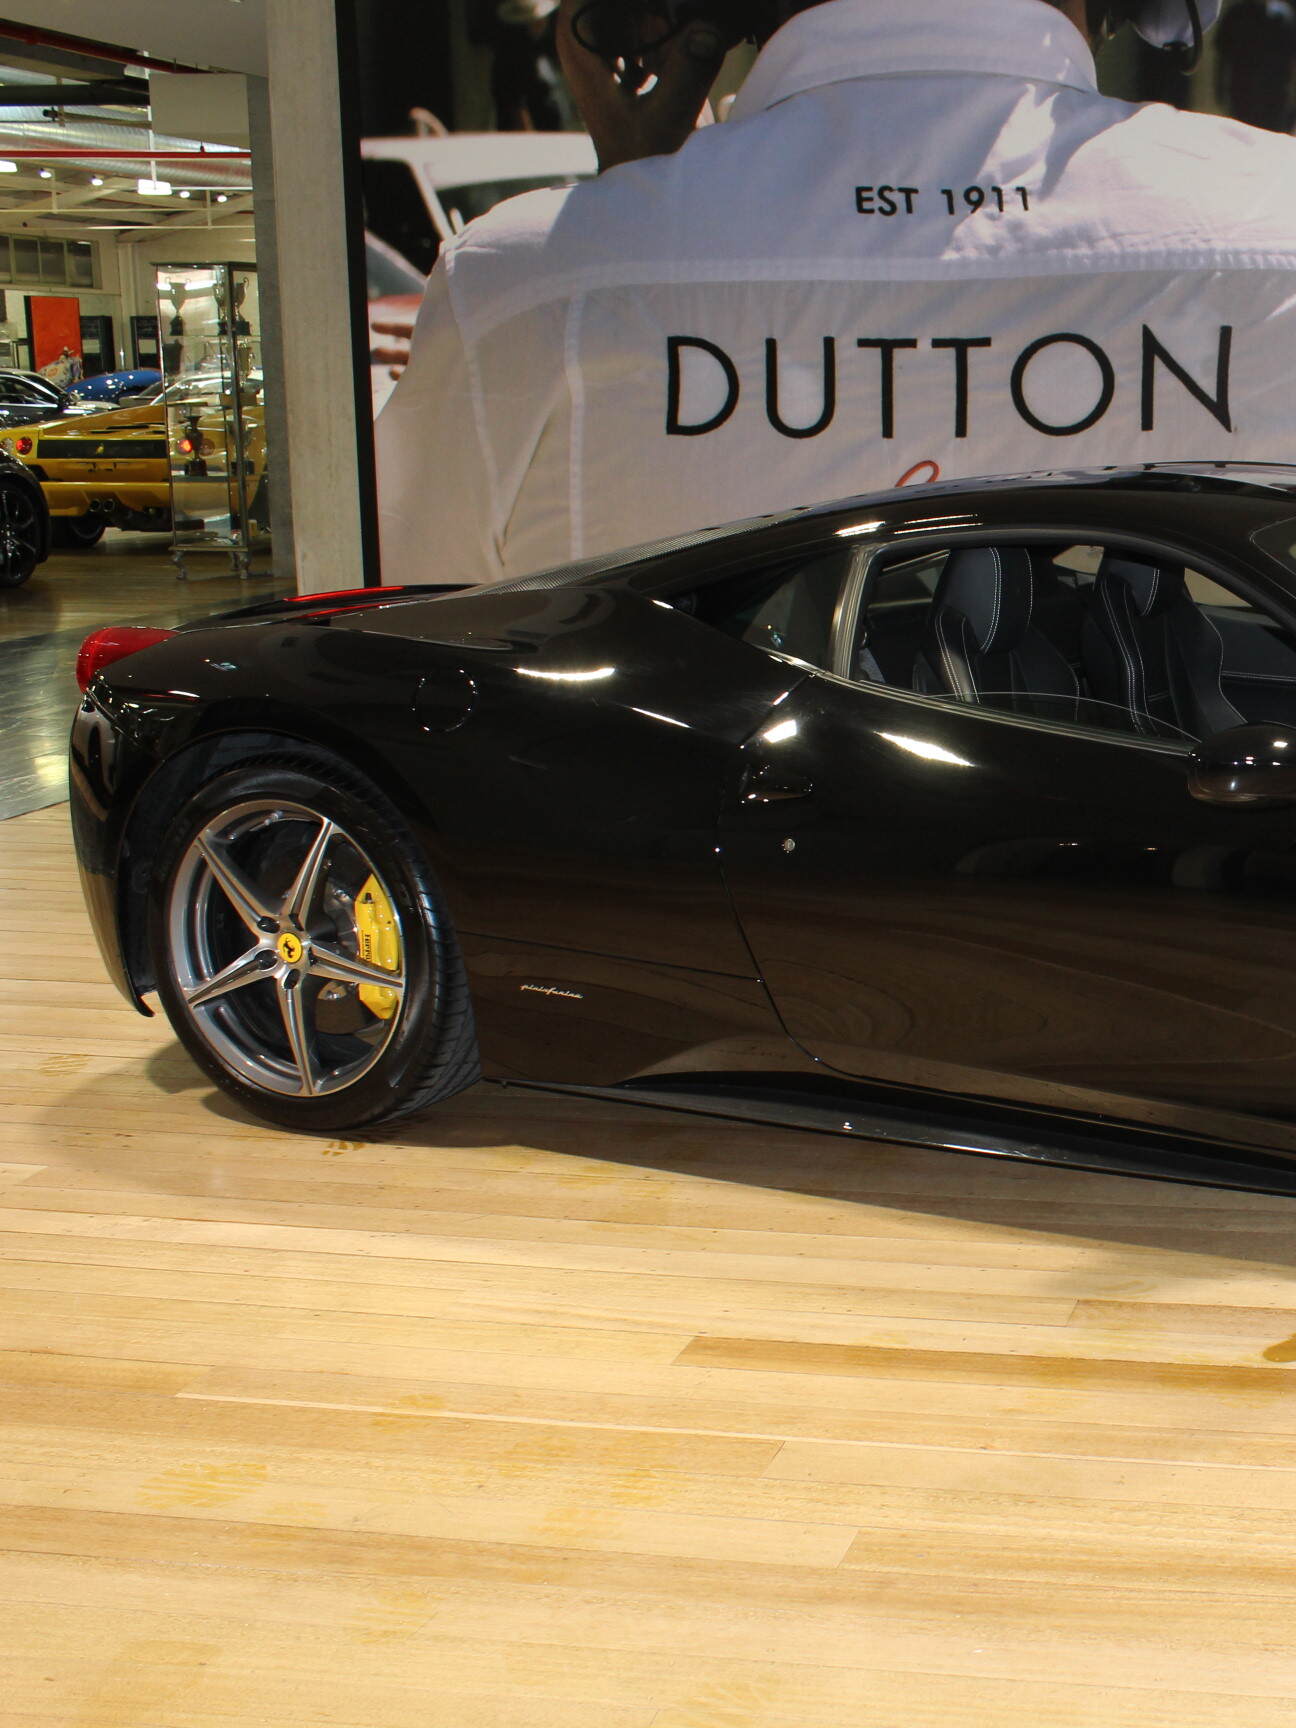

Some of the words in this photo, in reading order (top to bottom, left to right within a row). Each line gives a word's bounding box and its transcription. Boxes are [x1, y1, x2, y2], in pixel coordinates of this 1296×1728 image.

[855, 185, 919, 216] EST
[940, 185, 1029, 215] 1911
[666, 323, 1234, 440] DUTTON
